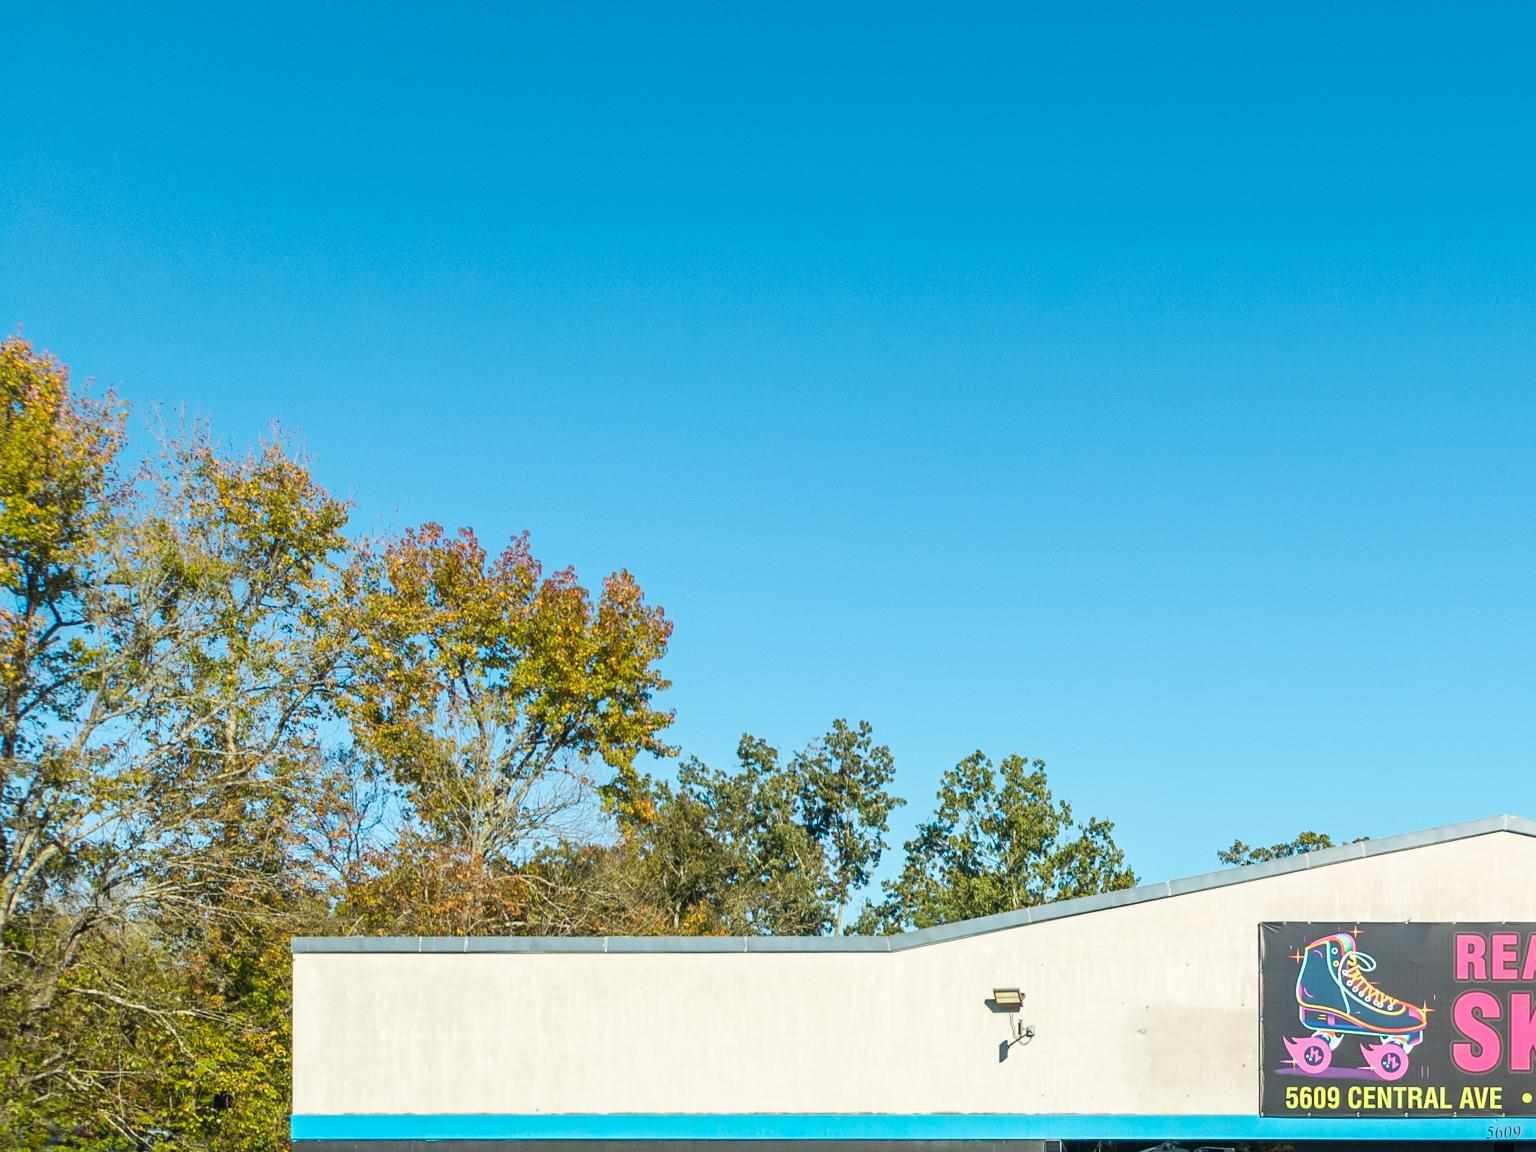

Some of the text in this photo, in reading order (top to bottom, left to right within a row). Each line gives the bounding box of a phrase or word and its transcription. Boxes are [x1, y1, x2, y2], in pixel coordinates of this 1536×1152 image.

[1284, 1086, 1340, 1110] 5609
[1347, 1086, 1450, 1110] CENTRAL
[1459, 1086, 1503, 1110] AVE
[1487, 1125, 1521, 1139] 5609
